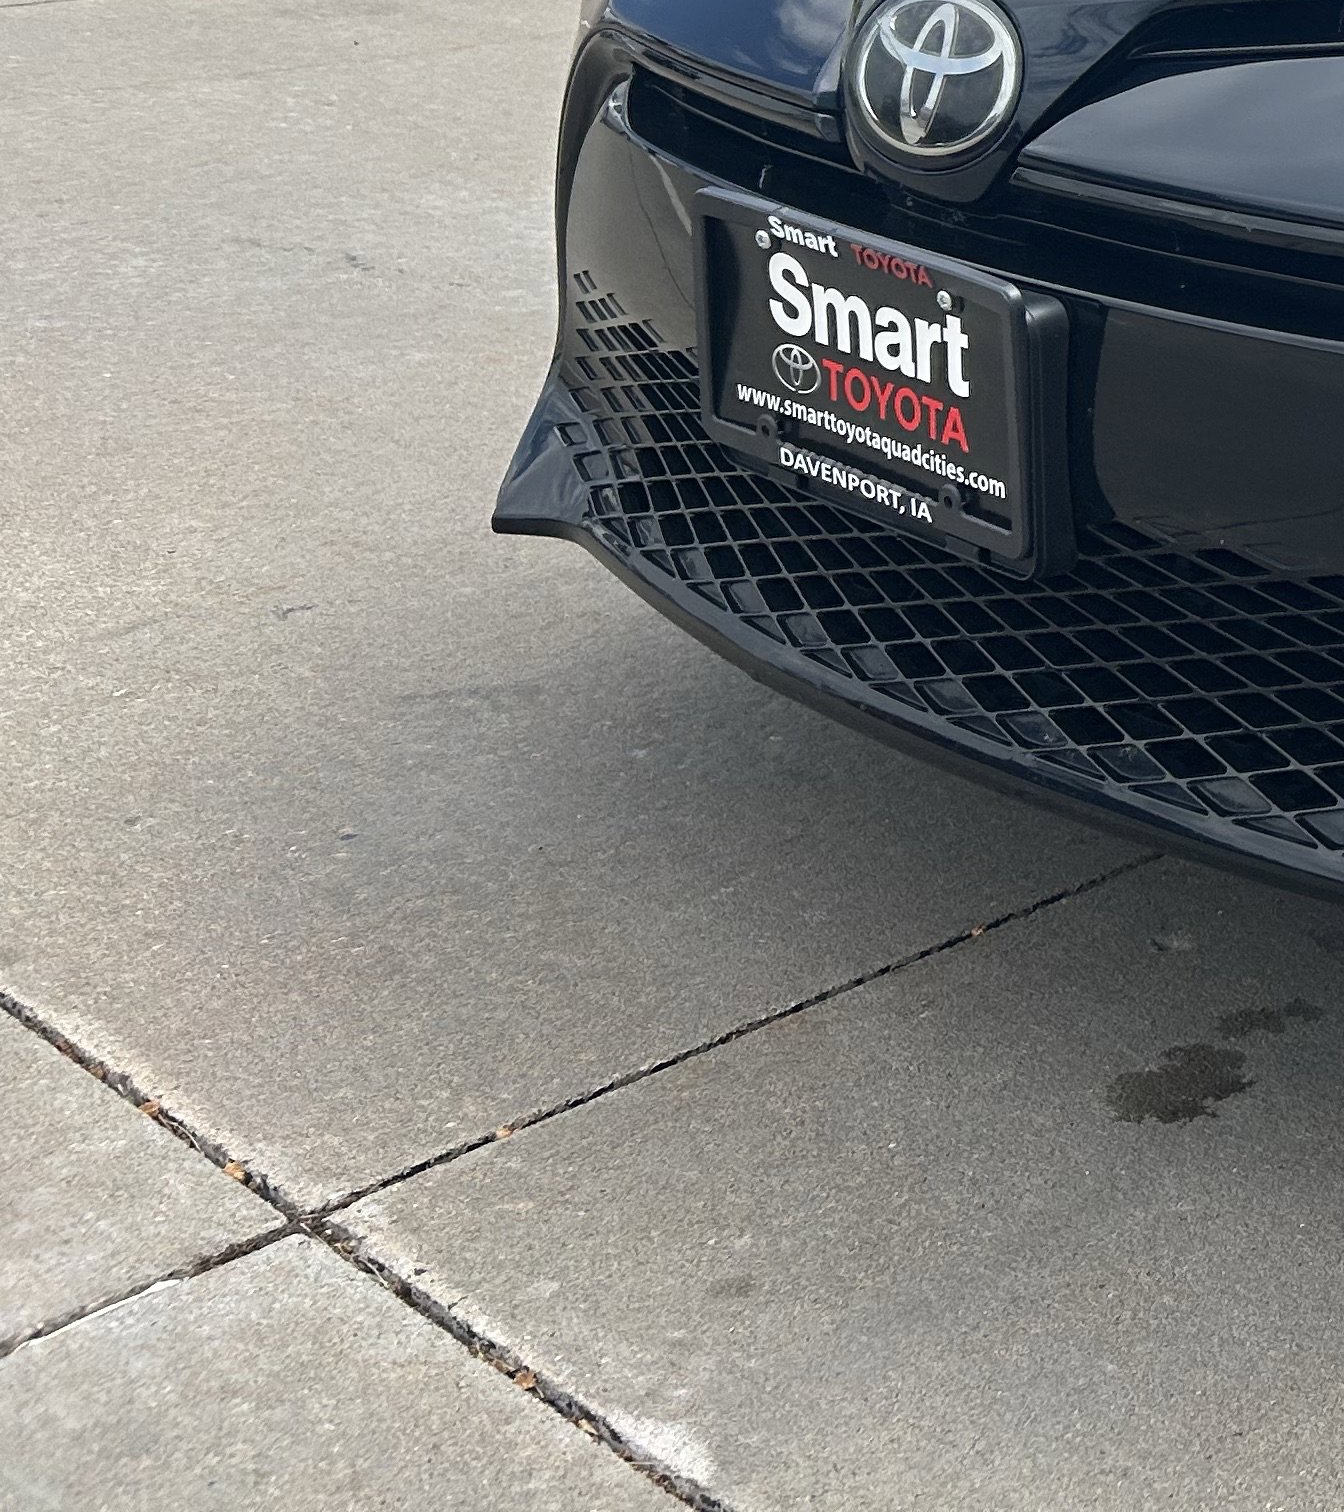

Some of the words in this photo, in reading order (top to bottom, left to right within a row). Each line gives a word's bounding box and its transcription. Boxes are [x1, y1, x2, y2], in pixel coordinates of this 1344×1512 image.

[767, 214, 839, 259] Smart
[851, 243, 933, 289] TOYOTA
[767, 251, 971, 399] Smart
[737, 382, 1007, 500] www.smarttoyotaquadcities.com
[822, 358, 970, 454] TOYOTA
[779, 446, 906, 516] DAVENPORT,
[911, 496, 933, 524] IA
